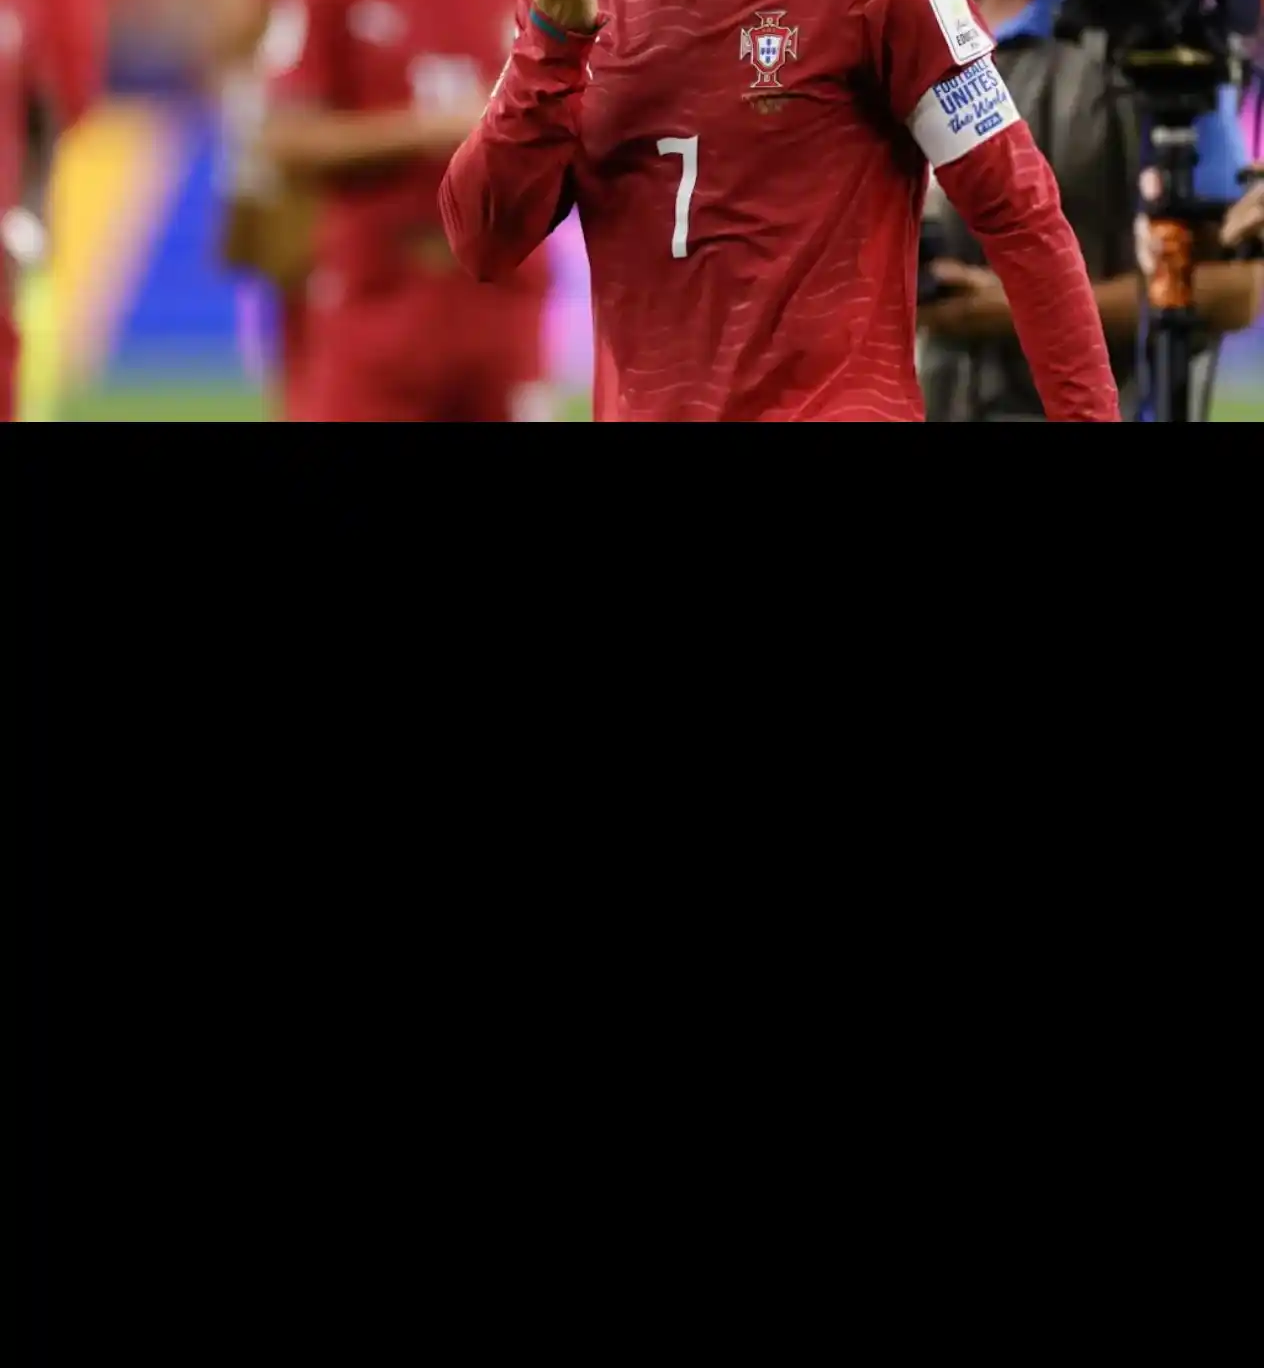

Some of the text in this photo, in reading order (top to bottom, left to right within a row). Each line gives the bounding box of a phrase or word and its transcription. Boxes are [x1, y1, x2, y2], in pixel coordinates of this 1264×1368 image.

[933, 59, 988, 97] FOOTBALL
[940, 70, 998, 114] UNITES
[948, 89, 1007, 134] the World
[977, 114, 1001, 135] FIFA
[656, 134, 699, 259] 7
